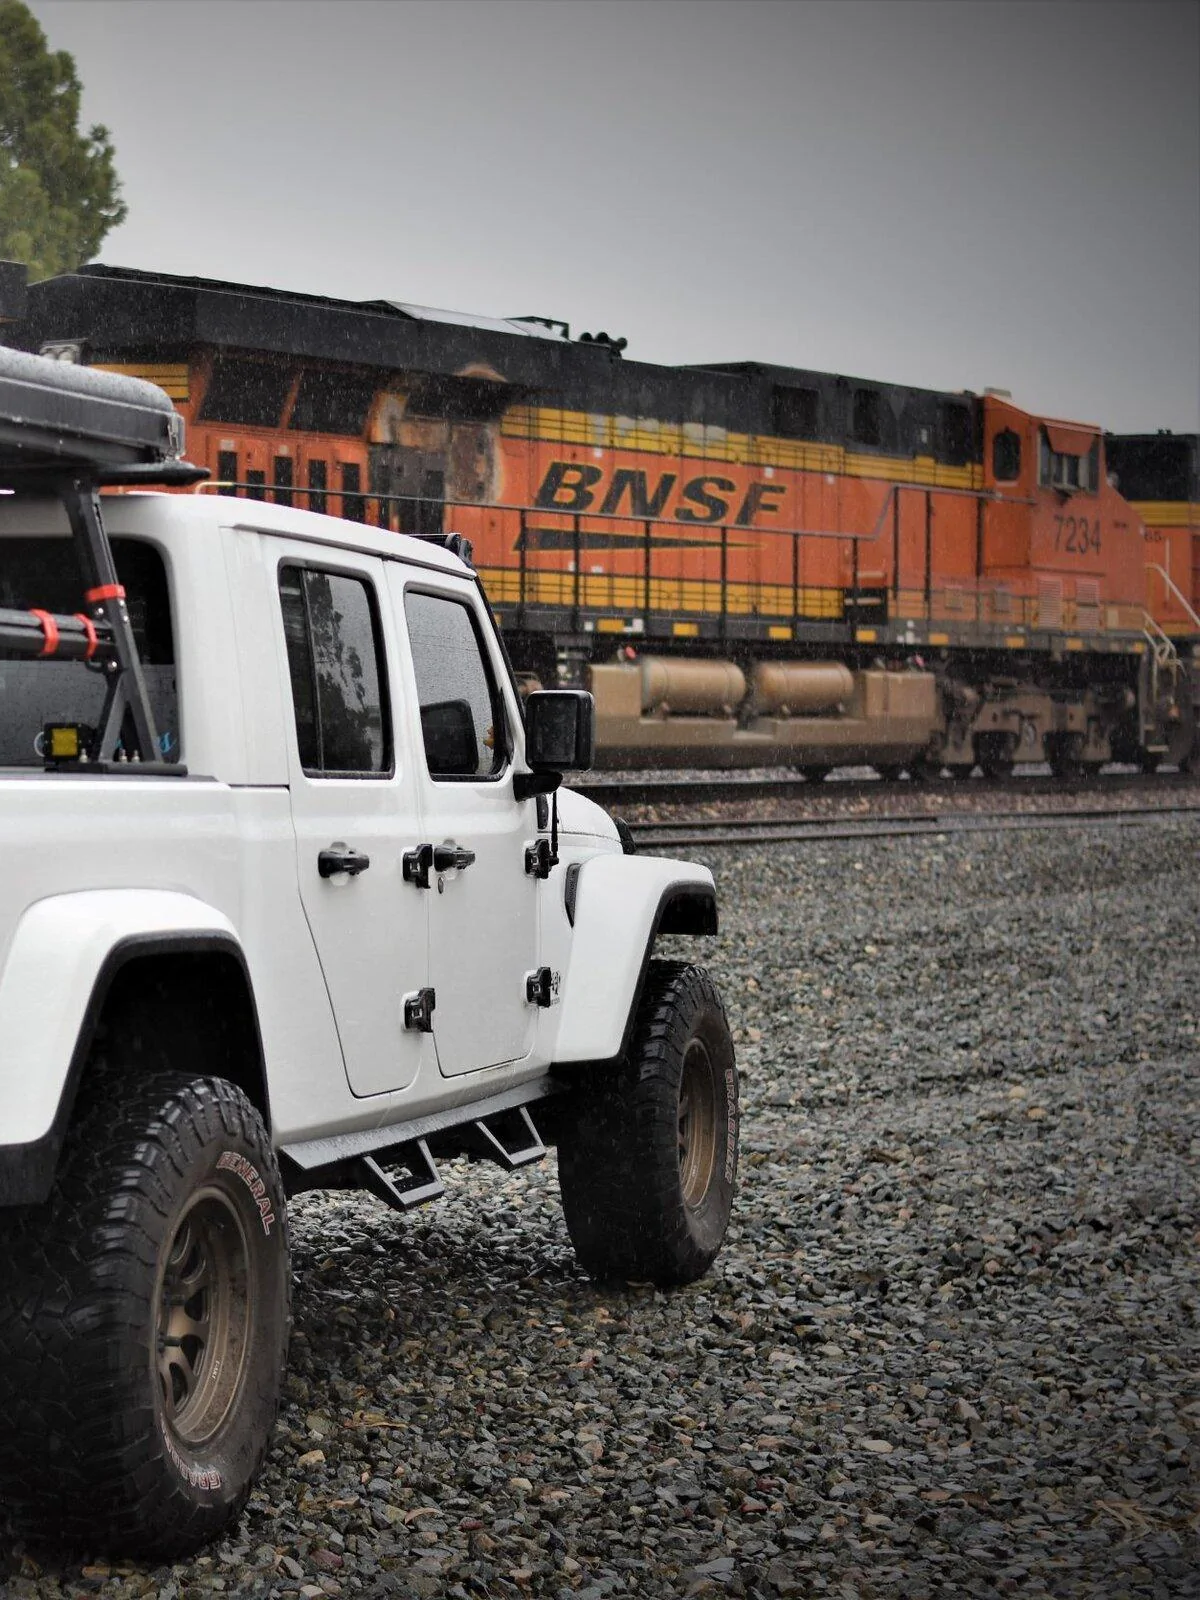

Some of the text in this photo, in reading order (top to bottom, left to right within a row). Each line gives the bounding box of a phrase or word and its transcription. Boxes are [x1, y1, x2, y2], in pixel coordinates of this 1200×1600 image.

[534, 461, 787, 526] BNSF
[1053, 513, 1102, 556] 7234
[216, 1151, 275, 1236] GENERAL
